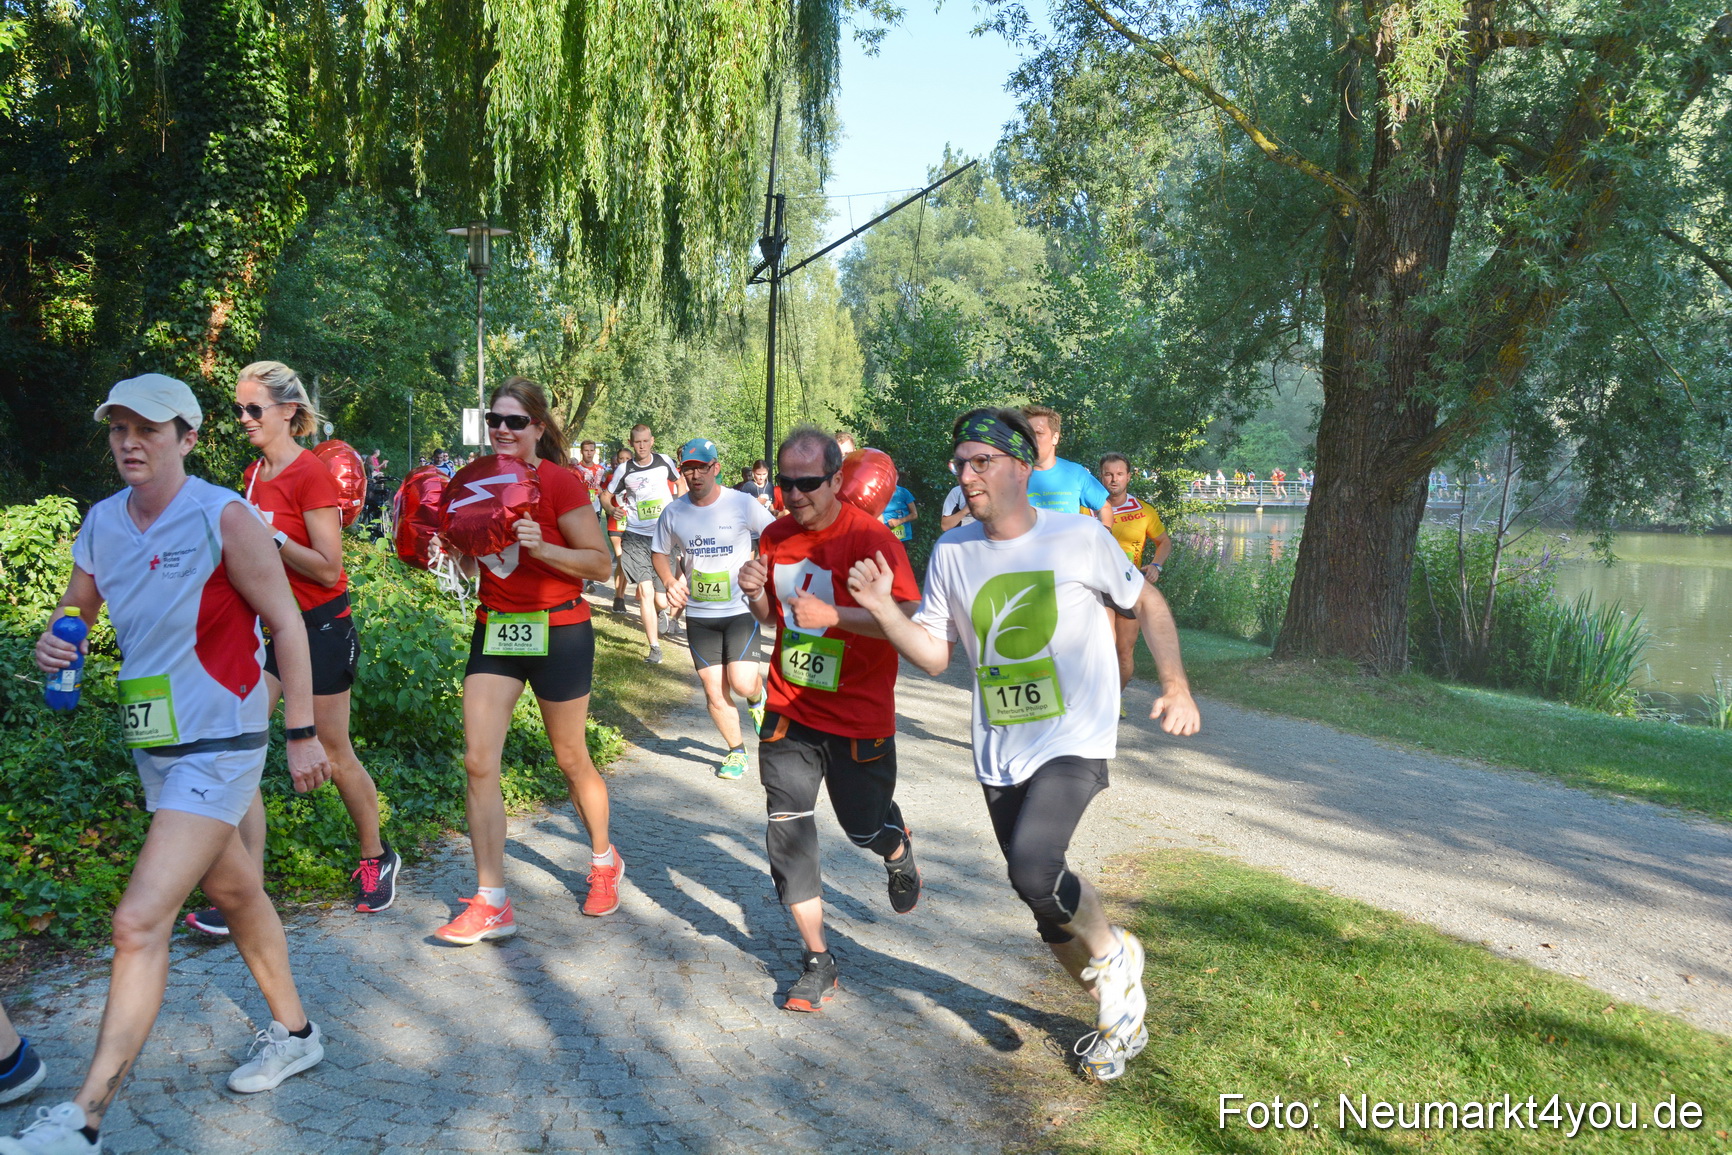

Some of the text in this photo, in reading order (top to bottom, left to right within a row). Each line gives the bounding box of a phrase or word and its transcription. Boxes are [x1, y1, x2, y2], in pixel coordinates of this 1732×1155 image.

[641, 505, 662, 515] 1475
[1120, 512, 1147, 522] BÖGL
[689, 535, 716, 548] KÖNIG
[685, 544, 734, 557] Engineering
[162, 567, 198, 580] Manuela
[697, 582, 721, 594] 974
[497, 623, 533, 642] 433
[789, 650, 825, 674] 426
[805, 671, 817, 679] Olaf
[996, 683, 1042, 708] 176
[1025, 704, 1048, 712] Philipp
